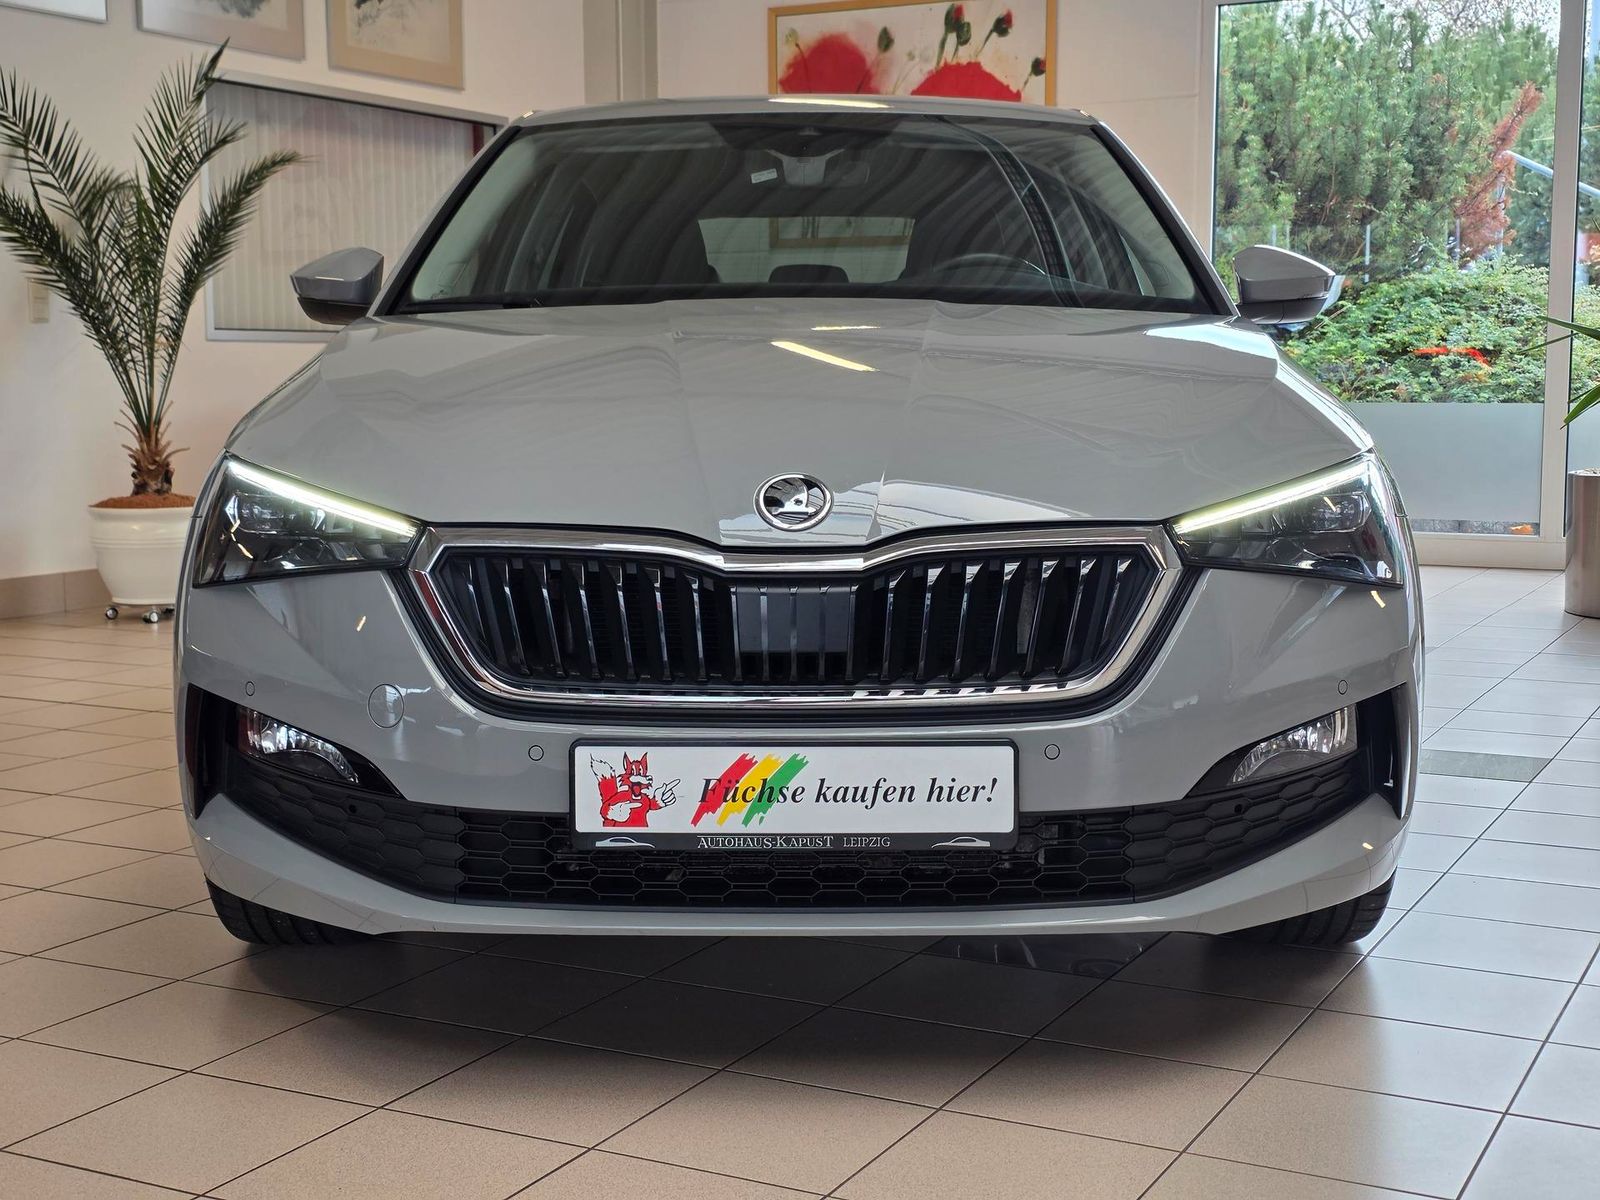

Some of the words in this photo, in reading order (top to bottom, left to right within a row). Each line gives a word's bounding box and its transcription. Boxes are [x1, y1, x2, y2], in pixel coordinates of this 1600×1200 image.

[698, 777, 806, 803] Füchse
[815, 777, 916, 810] kaufen
[926, 777, 998, 803] hier!
[843, 836, 891, 848] LEIPZIG
